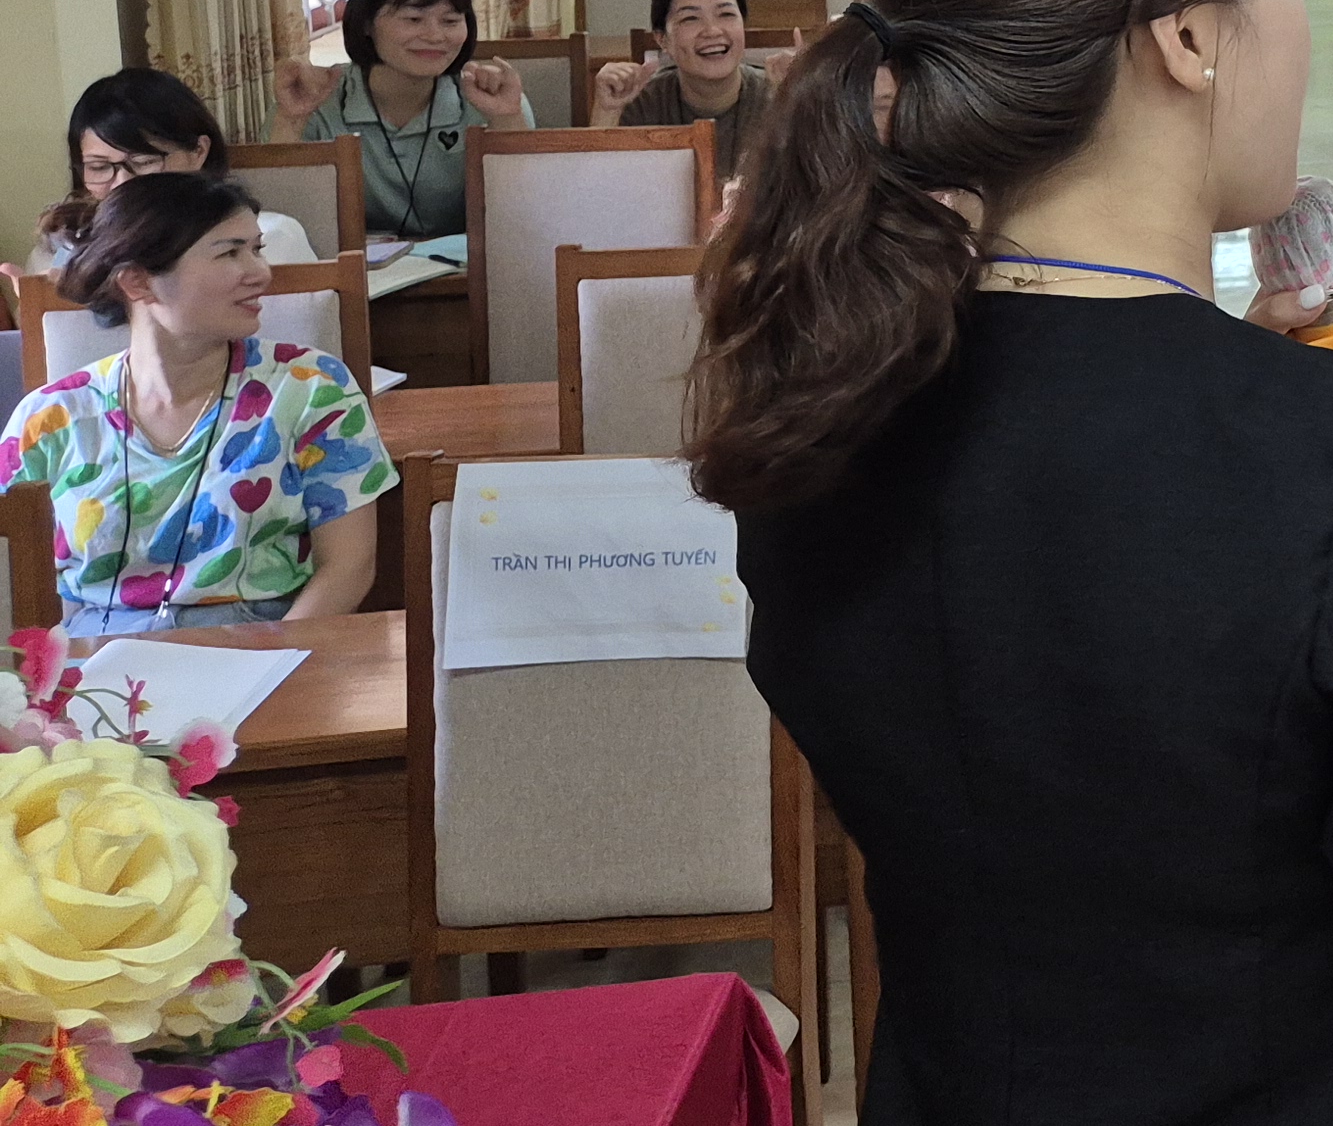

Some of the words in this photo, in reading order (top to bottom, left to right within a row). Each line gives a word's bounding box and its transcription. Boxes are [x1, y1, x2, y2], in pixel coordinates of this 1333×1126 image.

[491, 552, 538, 572] TRẦN
[543, 554, 572, 573] THỊ
[578, 551, 656, 570] PHƯƠNG
[661, 547, 717, 566] TUYẾN
